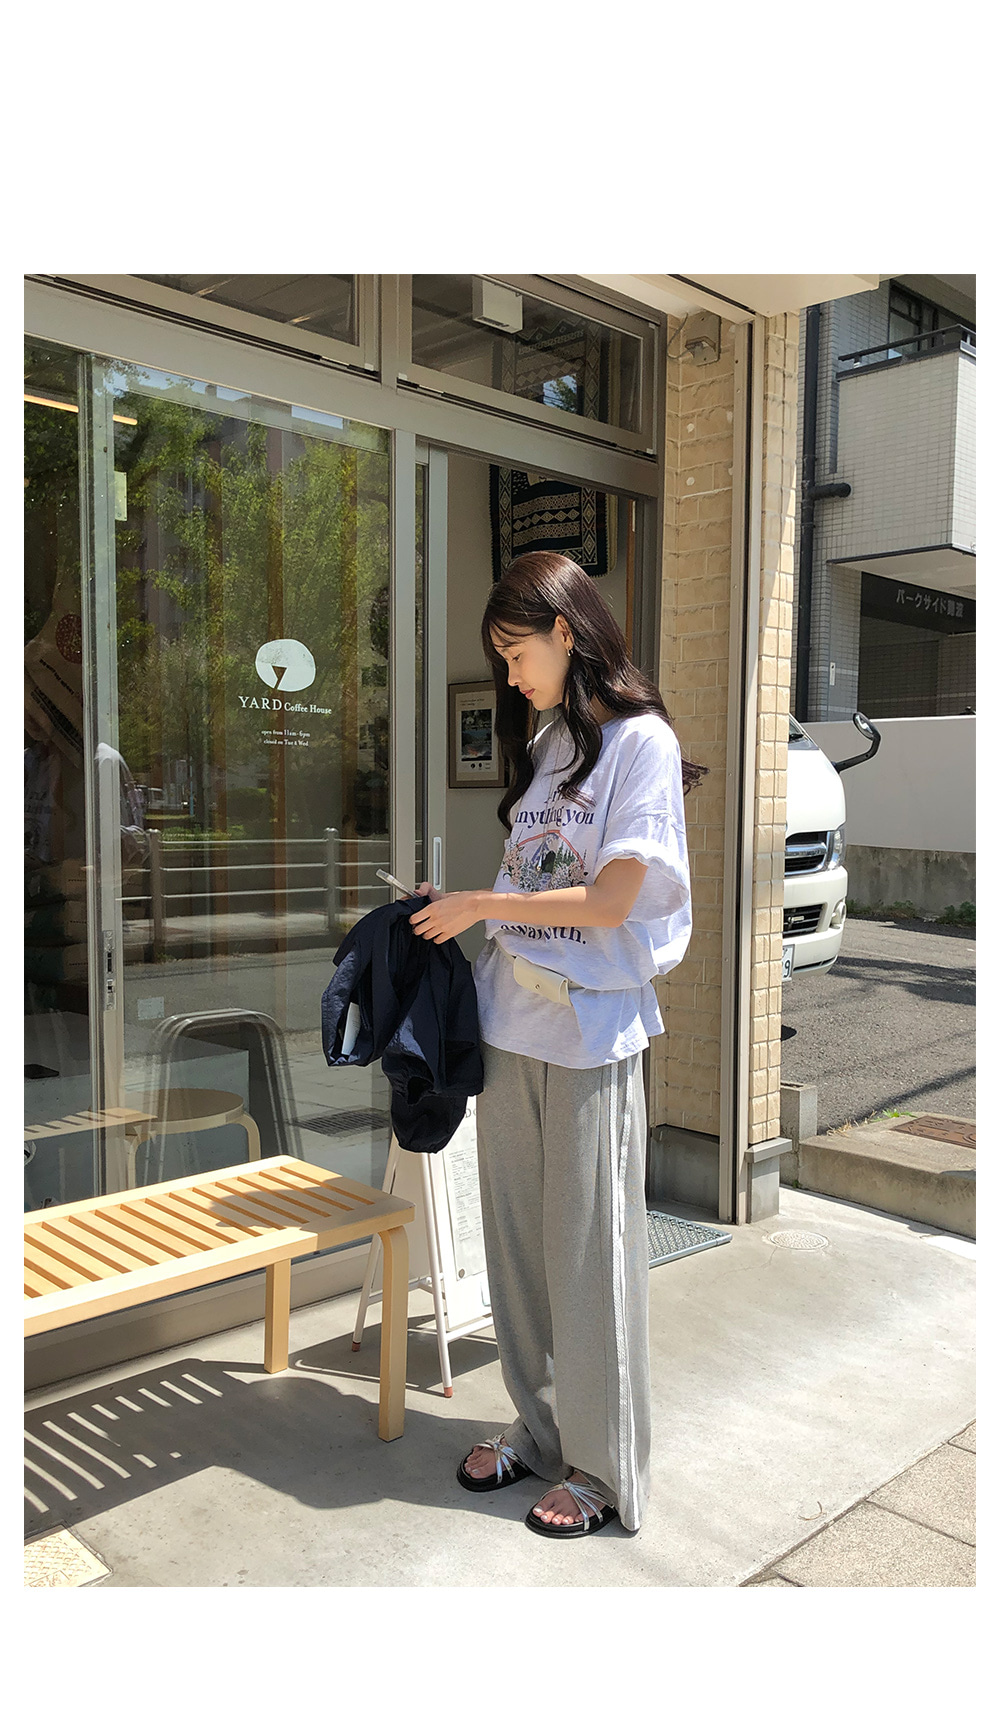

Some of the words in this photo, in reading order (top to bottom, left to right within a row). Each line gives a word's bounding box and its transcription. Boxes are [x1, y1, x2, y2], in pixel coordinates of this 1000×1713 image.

[238, 696, 282, 711] YARD
[284, 702, 308, 712] Coffee
[310, 705, 332, 714] House
[562, 809, 595, 826] you
